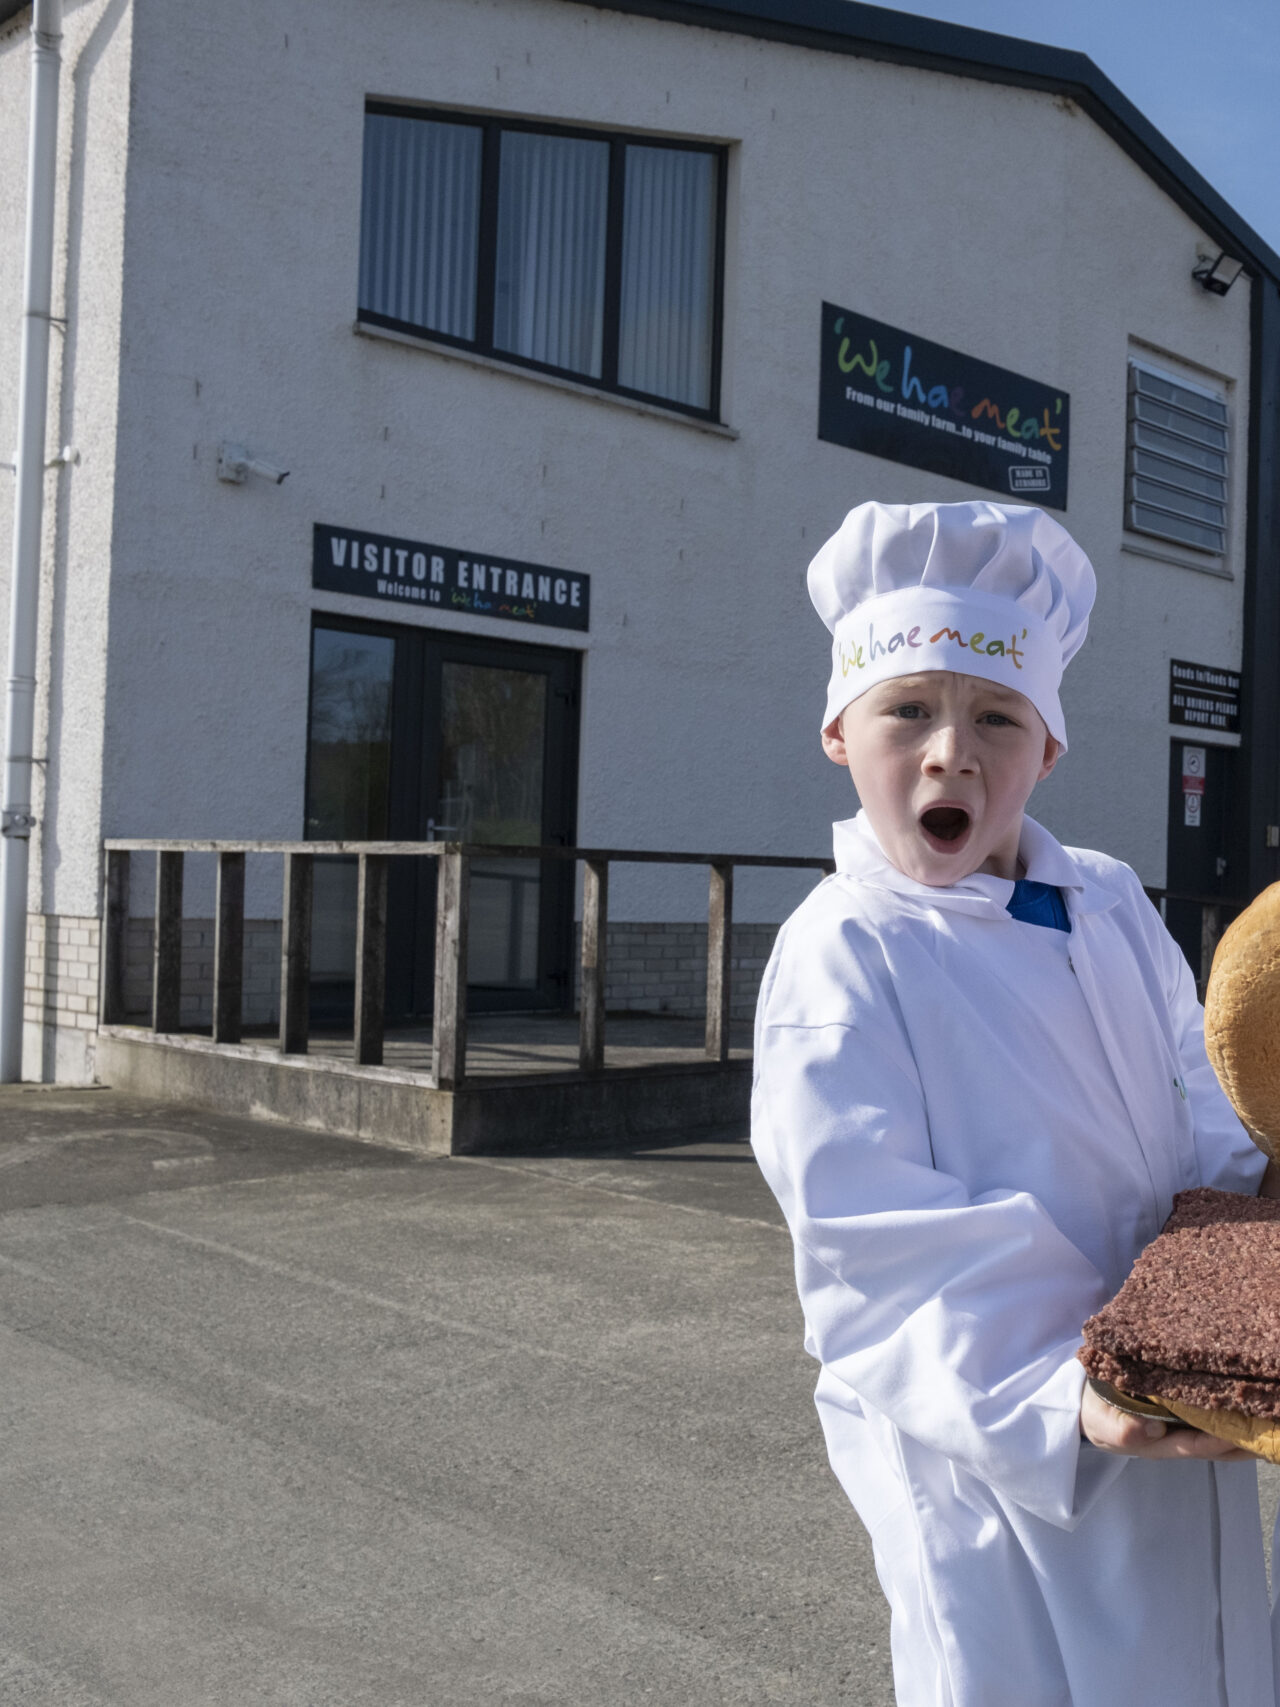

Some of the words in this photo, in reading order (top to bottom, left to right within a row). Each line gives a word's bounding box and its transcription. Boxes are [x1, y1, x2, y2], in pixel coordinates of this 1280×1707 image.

[902, 346, 965, 417] hae
[971, 398, 1062, 451] meat'
[845, 386, 875, 408] From
[875, 398, 896, 414] our
[896, 403, 931, 427] family
[973, 430, 997, 447] your
[997, 435, 1027, 458] family
[1027, 447, 1052, 465] table
[331, 537, 445, 584] VISITOR
[457, 560, 581, 607] ENTRANCE
[376, 579, 426, 600] Welcome
[429, 588, 441, 603] to
[838, 640, 866, 678] 'We
[869, 622, 923, 661] hae
[929, 627, 1028, 670] meat'
[1173, 665, 1195, 681] Goods
[1227, 675, 1240, 689] Out
[1172, 694, 1185, 707] ALL
[1186, 696, 1214, 712] DRIVERS
[1215, 701, 1238, 716] PLEASE
[1184, 709, 1209, 724] REPORT
[1210, 713, 1227, 727] HERE
